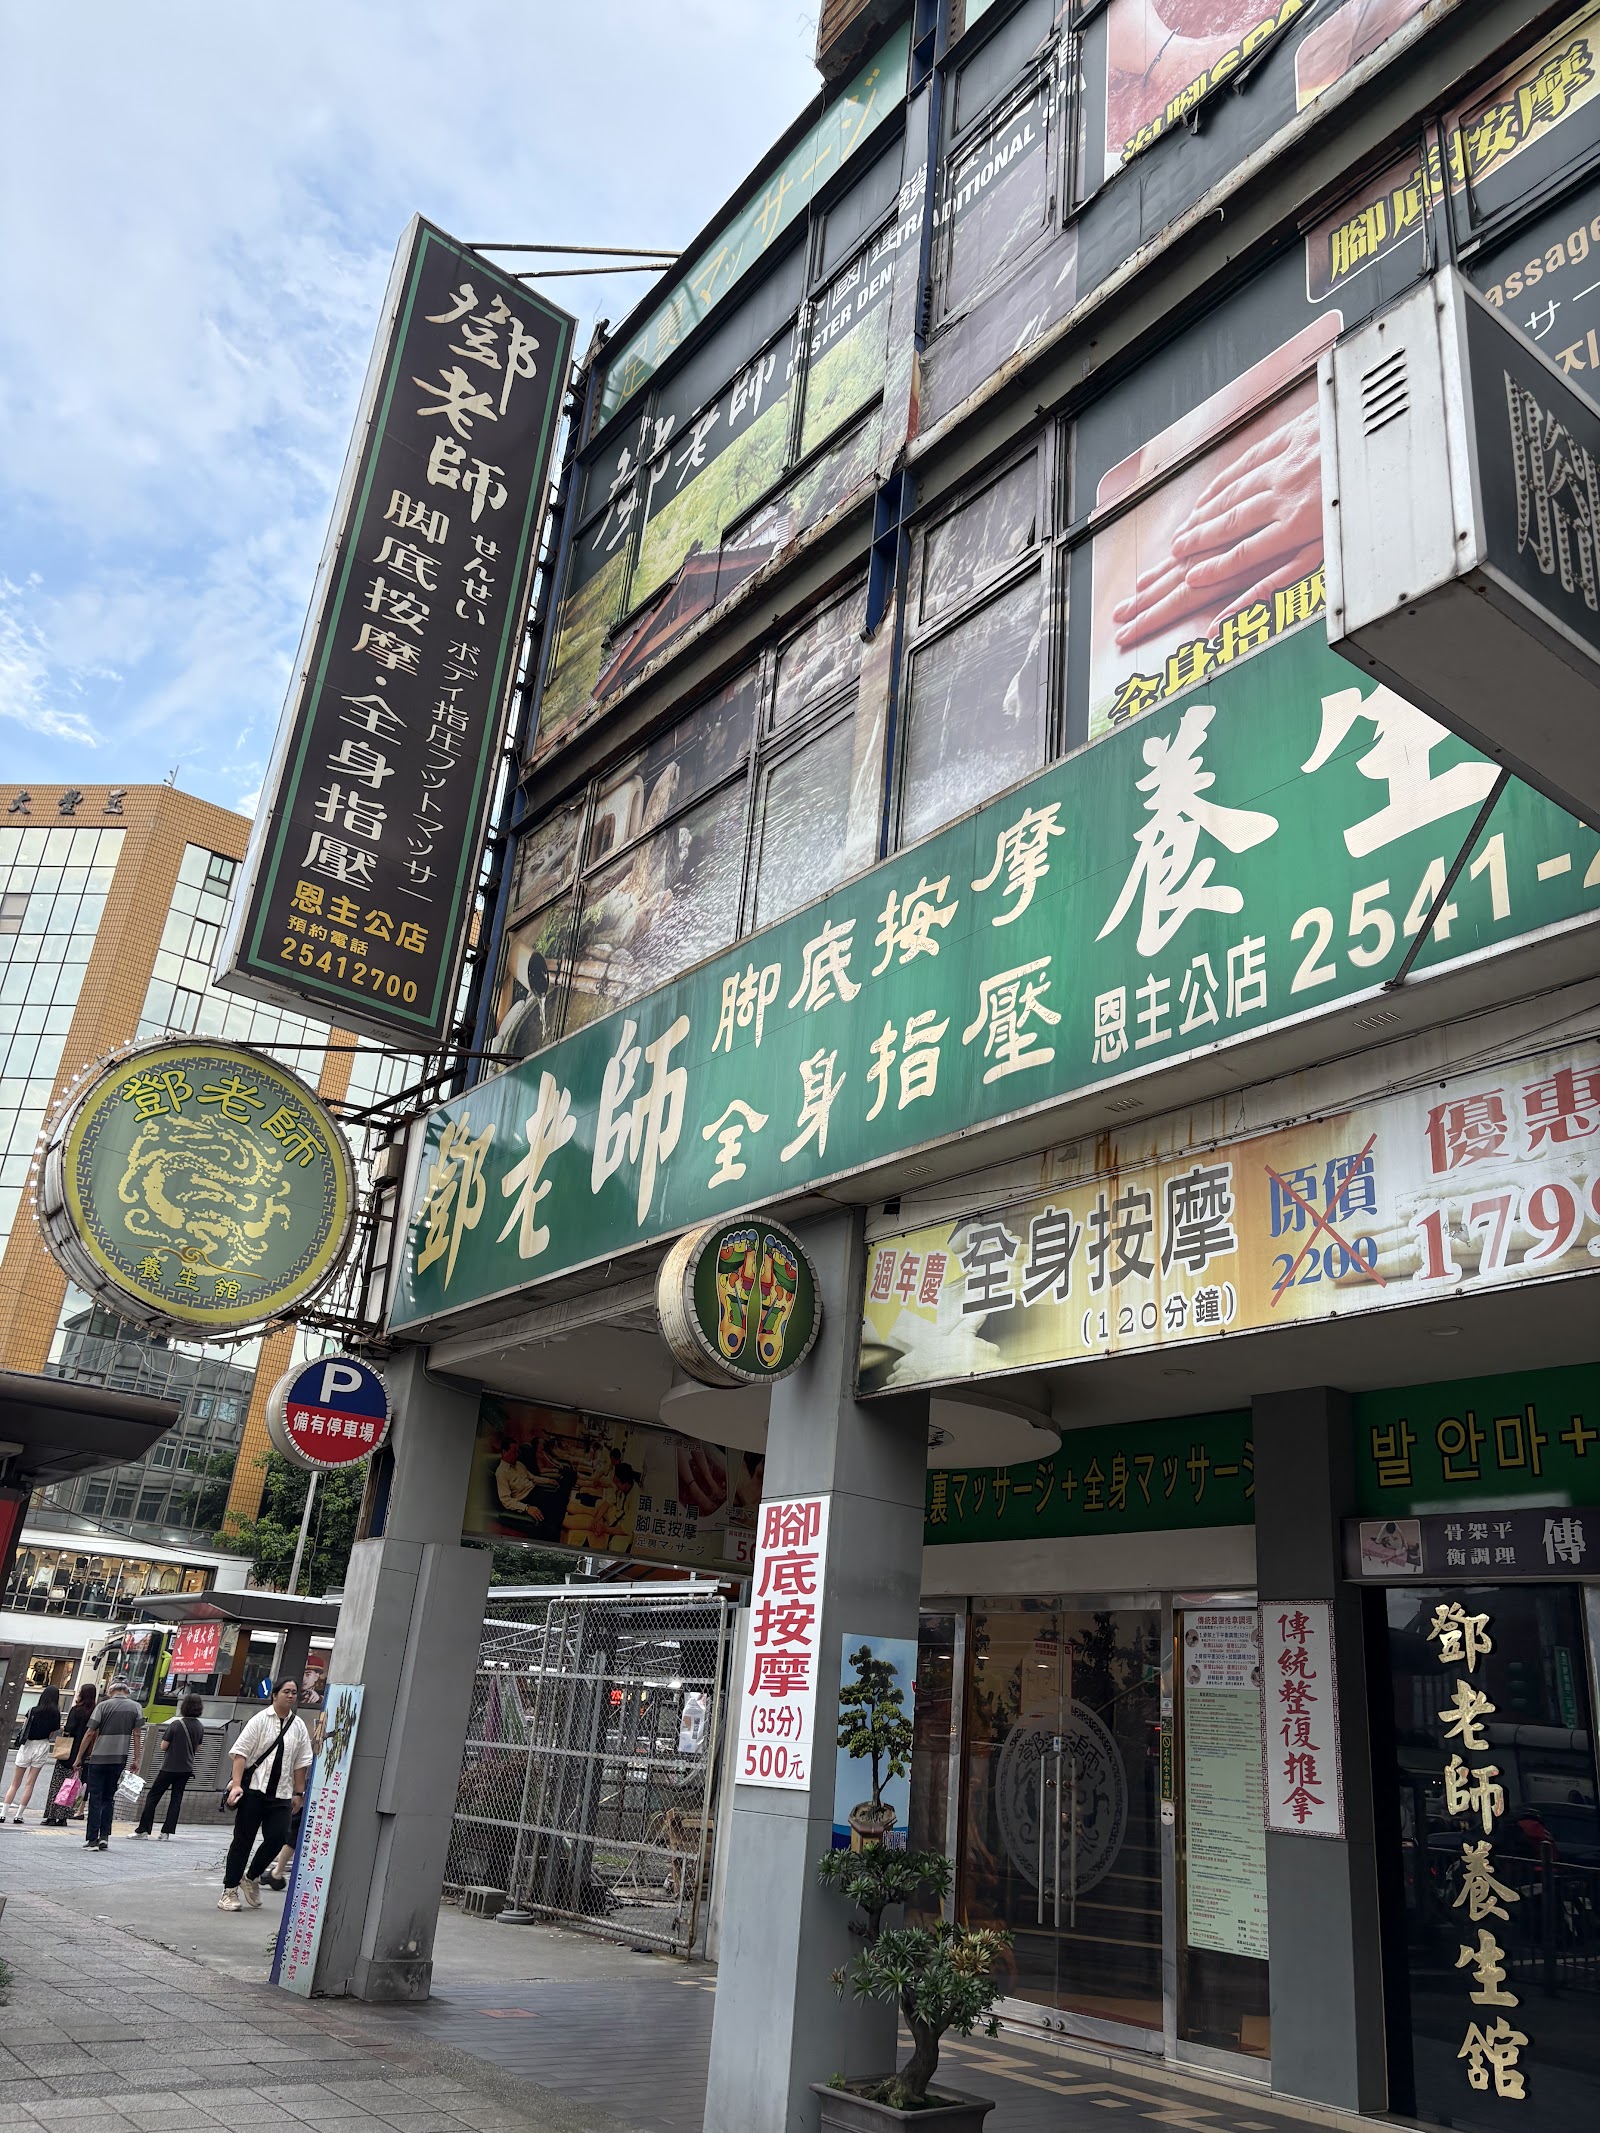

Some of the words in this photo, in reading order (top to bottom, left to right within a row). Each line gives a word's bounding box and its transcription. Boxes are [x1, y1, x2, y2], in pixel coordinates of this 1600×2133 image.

[1331, 38, 1593, 284] 腳底按摩
[615, 67, 882, 410] 足裏マッサージ
[856, 261, 895, 313] DEN
[411, 282, 540, 524] 鄧老師
[455, 534, 502, 626] せんせい
[1115, 566, 1327, 722] 全身指壓
[287, 914, 370, 957] 預約電話
[290, 879, 430, 955] 恩主公店
[1092, 935, 1269, 1065] 恩主公店
[1290, 820, 1600, 995] 2541-
[280, 937, 418, 1003] 25412700
[702, 955, 1062, 1190] 全身指壓
[122, 1069, 327, 1169] 鄧老師
[417, 1015, 690, 1292] 鄧老師
[1269, 1149, 1378, 1238] 原價
[1416, 1180, 1600, 1282] 179
[869, 1250, 948, 1306] 週年慶
[961, 1166, 1235, 1315] 全身按摩
[1271, 1236, 1378, 1291] 2200
[318, 1362, 363, 1404] P
[292, 1409, 376, 1443] 備有停車場
[1371, 1418, 1416, 1489] 발
[635, 1514, 698, 1541] 腳底按摩
[1444, 1520, 1514, 1542] 骨架平
[1446, 1546, 1517, 1566] 衡調理
[1541, 1517, 1587, 1565] 傳
[748, 1501, 822, 1698] 腳底按摩
[750, 1705, 803, 1741] (35分)
[1277, 1610, 1326, 1825] 傳統整復推拿
[744, 1744, 805, 1780] 500元
